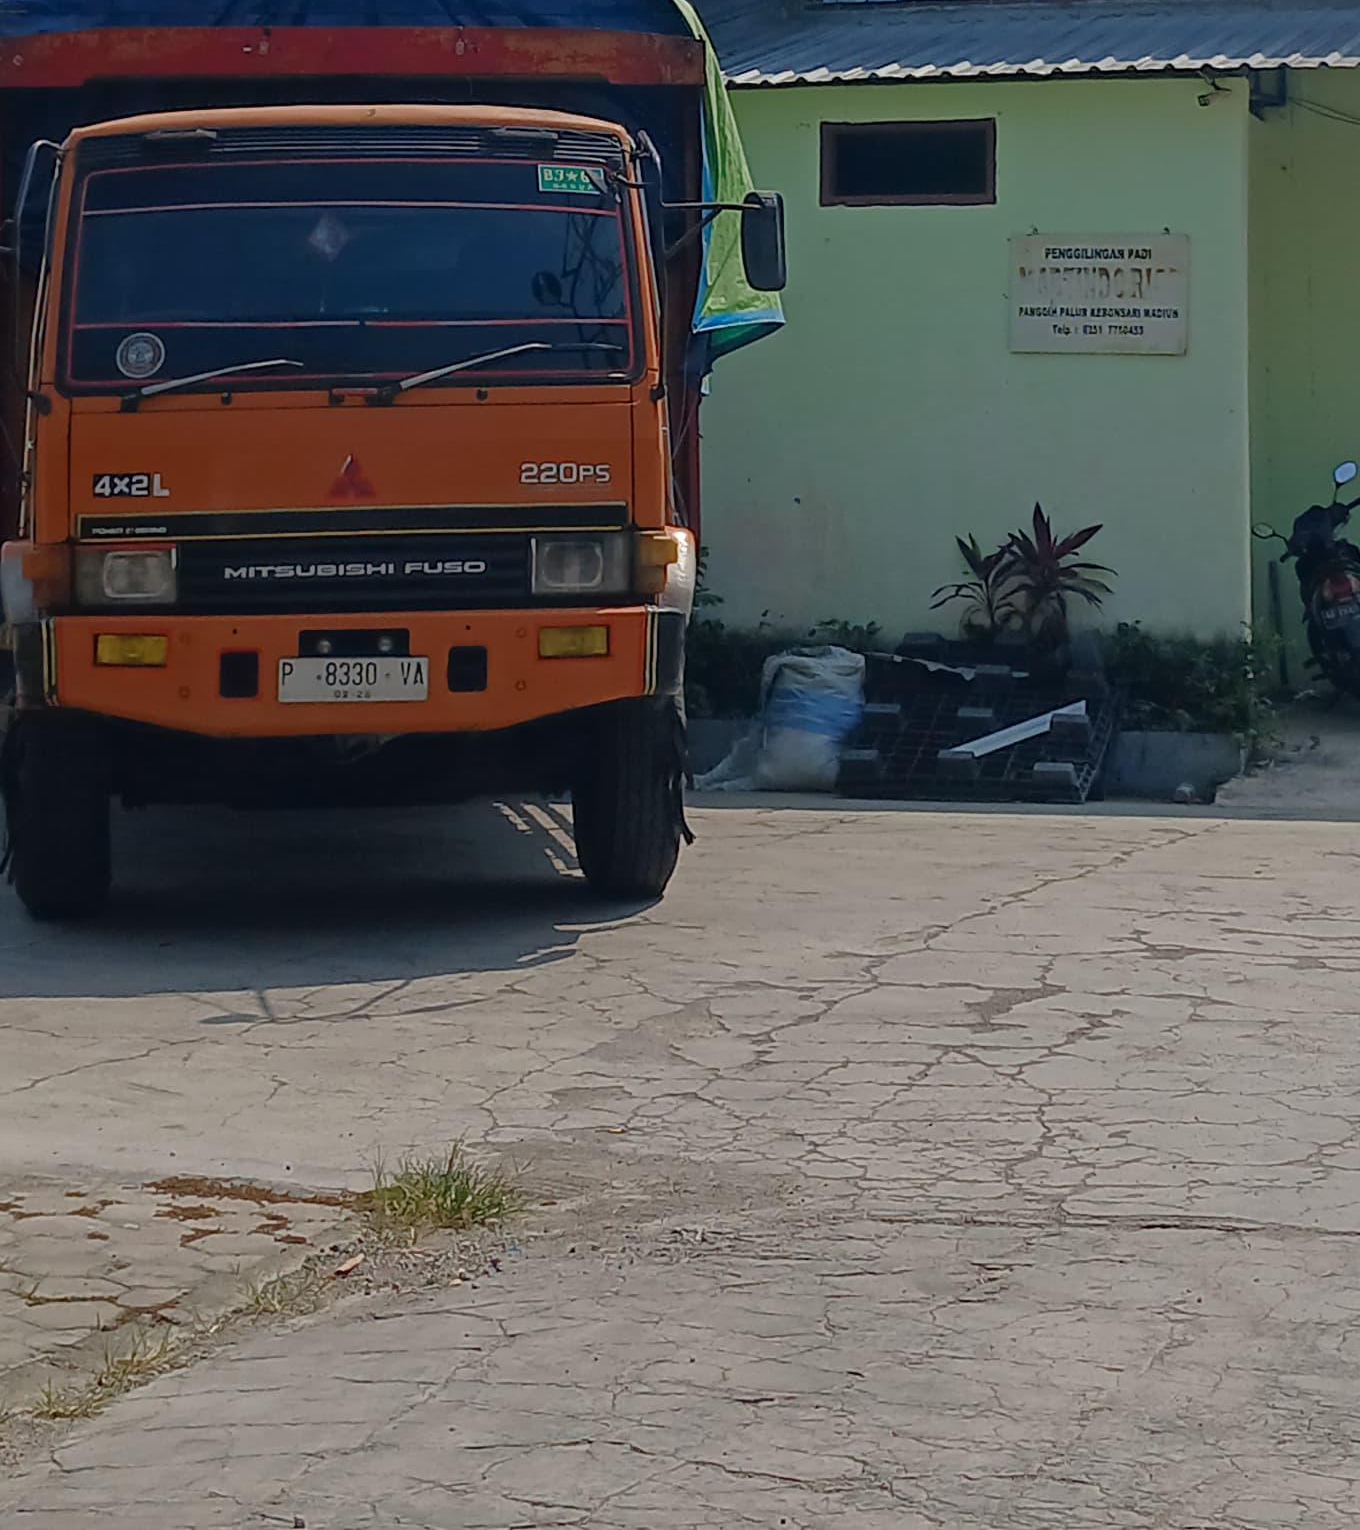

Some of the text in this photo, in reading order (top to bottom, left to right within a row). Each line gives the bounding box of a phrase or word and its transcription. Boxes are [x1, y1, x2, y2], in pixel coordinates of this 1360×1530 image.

[1045, 247, 1152, 260] PENGGILINGAN PADI
[521, 463, 610, 483] 220PS
[224, 561, 486, 579] MITSUBISHI FUSO
[282, 661, 424, 686] P 8330 VA
